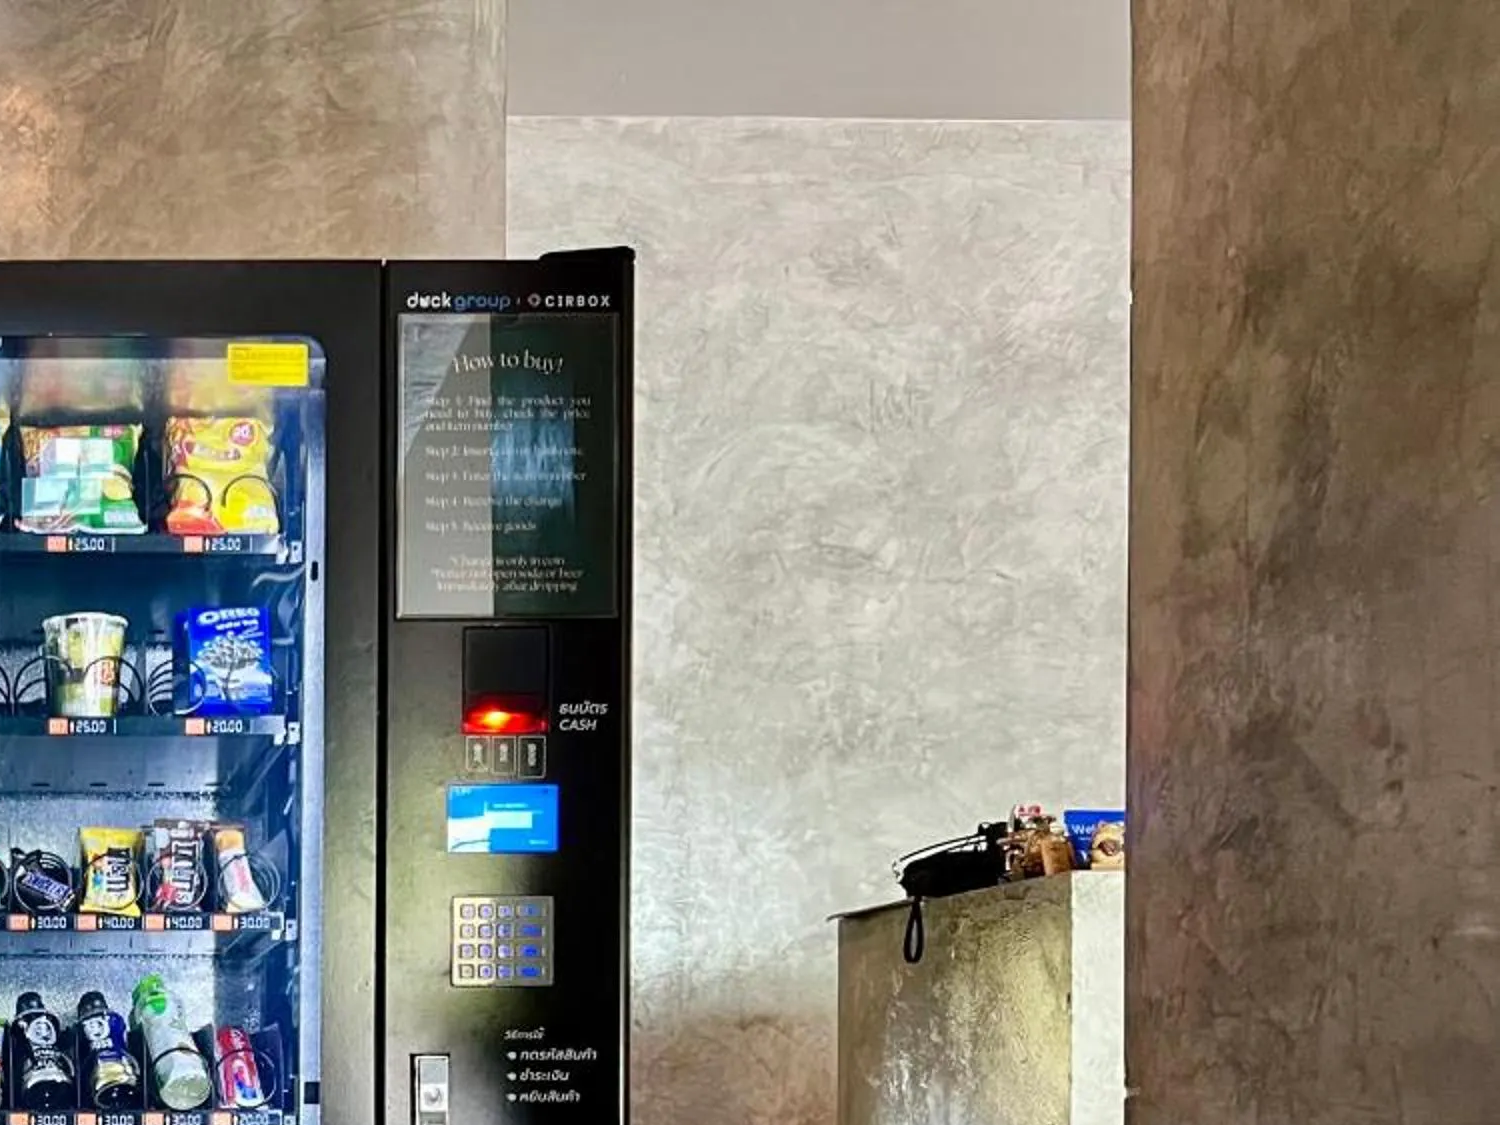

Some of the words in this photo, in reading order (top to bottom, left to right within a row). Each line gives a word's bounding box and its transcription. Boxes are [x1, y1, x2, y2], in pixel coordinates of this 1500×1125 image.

[454, 294, 511, 313] group
[545, 295, 611, 308] CIRBOX
[452, 352, 494, 374] How
[500, 352, 520, 369] to
[74, 537, 106, 551] 25.00
[211, 537, 242, 551] 25.00
[558, 719, 598, 731] CASH
